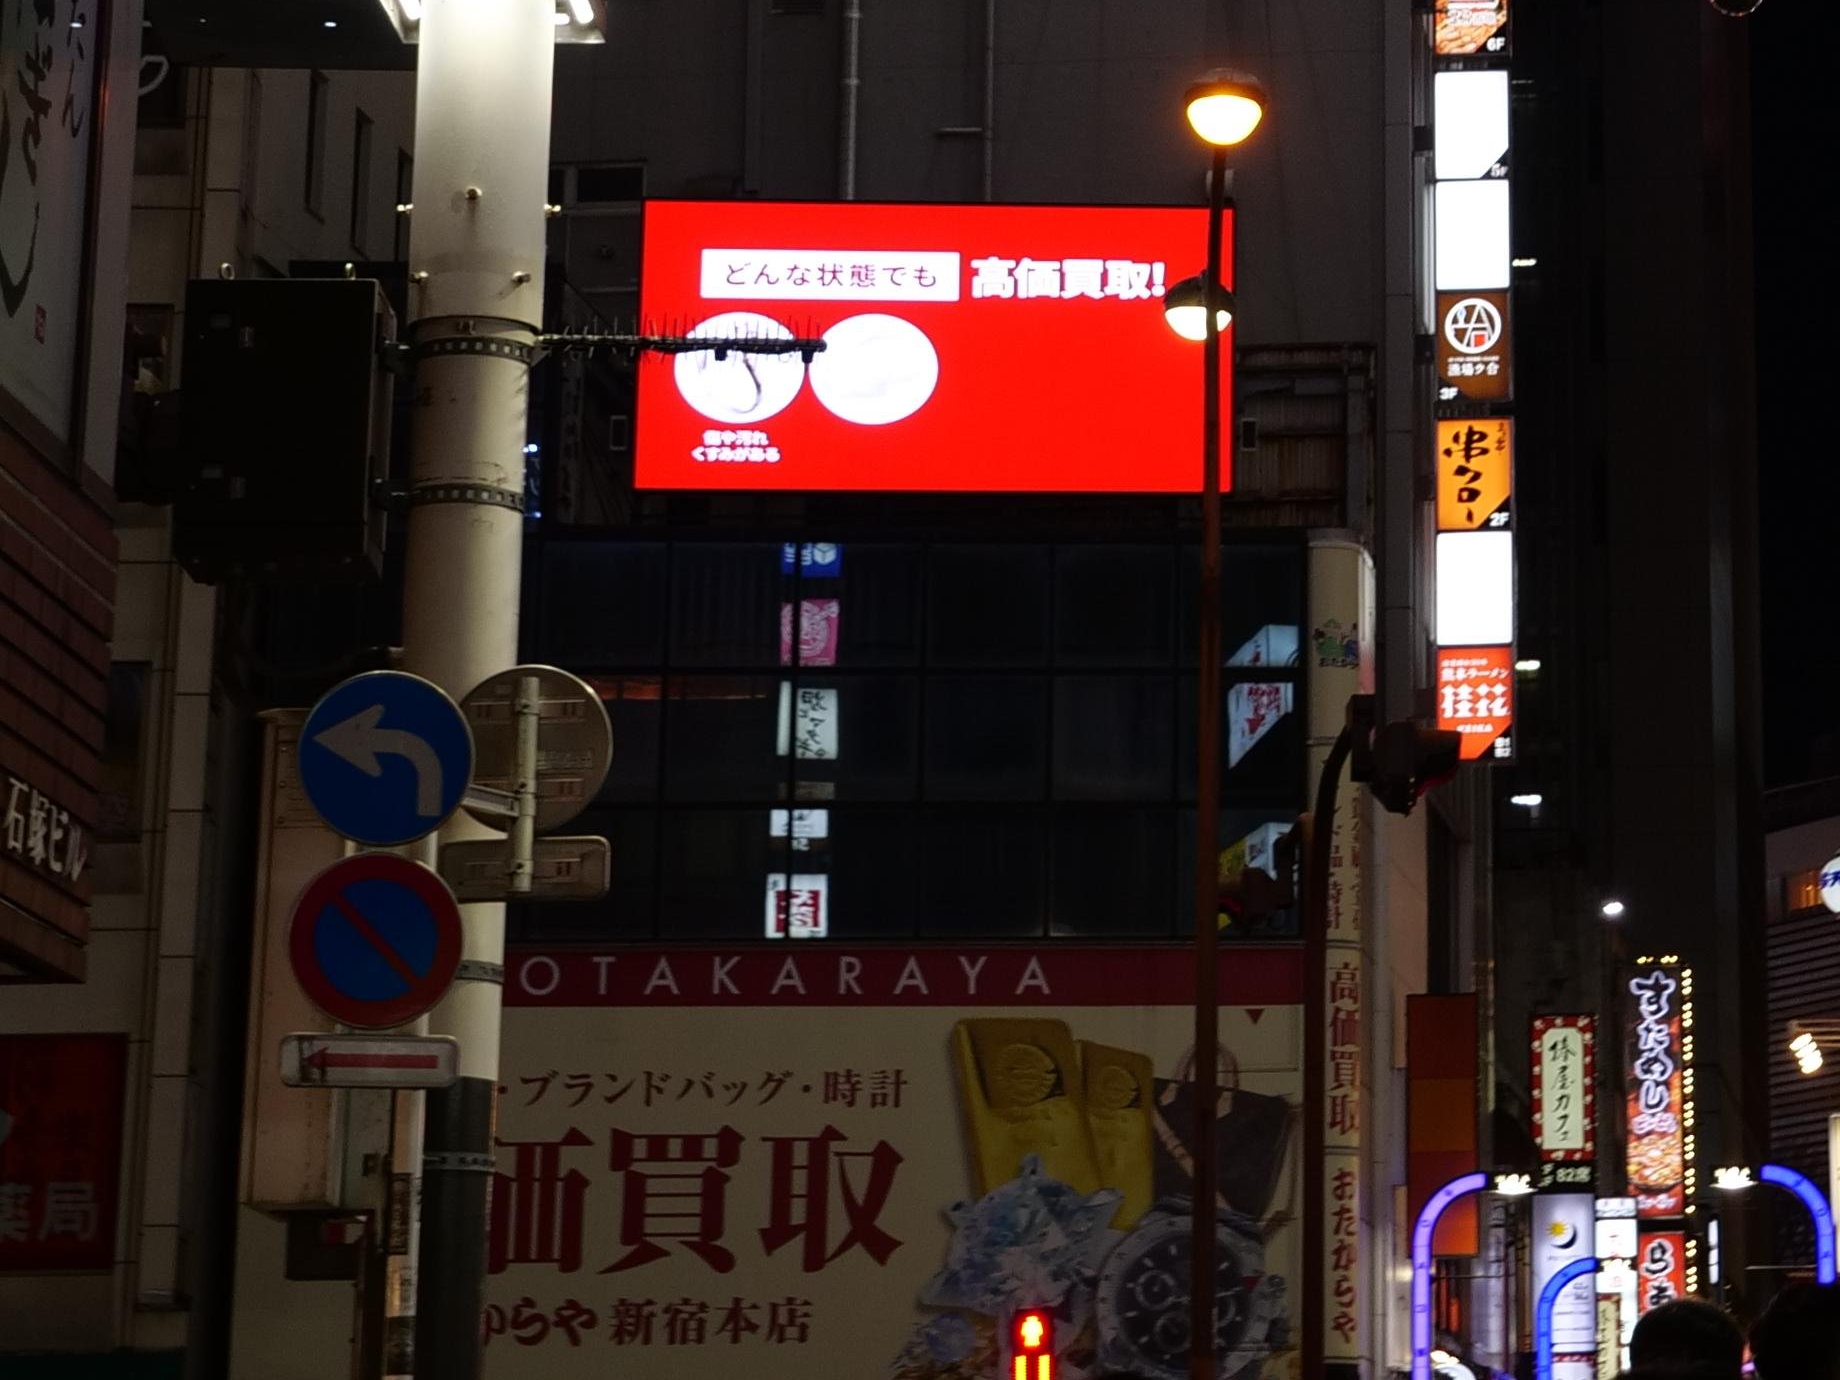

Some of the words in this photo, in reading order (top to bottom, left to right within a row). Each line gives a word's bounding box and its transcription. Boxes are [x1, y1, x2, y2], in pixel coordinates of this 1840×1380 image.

[1486, 37, 1506, 51] 6F
[726, 261, 937, 289] どんな状態でも
[1489, 511, 1511, 527] 2F
[6, 776, 88, 883] 石塚ビル
[519, 955, 1051, 996] OTAKARAYA
[1328, 961, 1360, 1135] 高価買取
[1332, 1168, 1357, 1344] おたからや
[609, 1296, 814, 1347] 新宿本店
